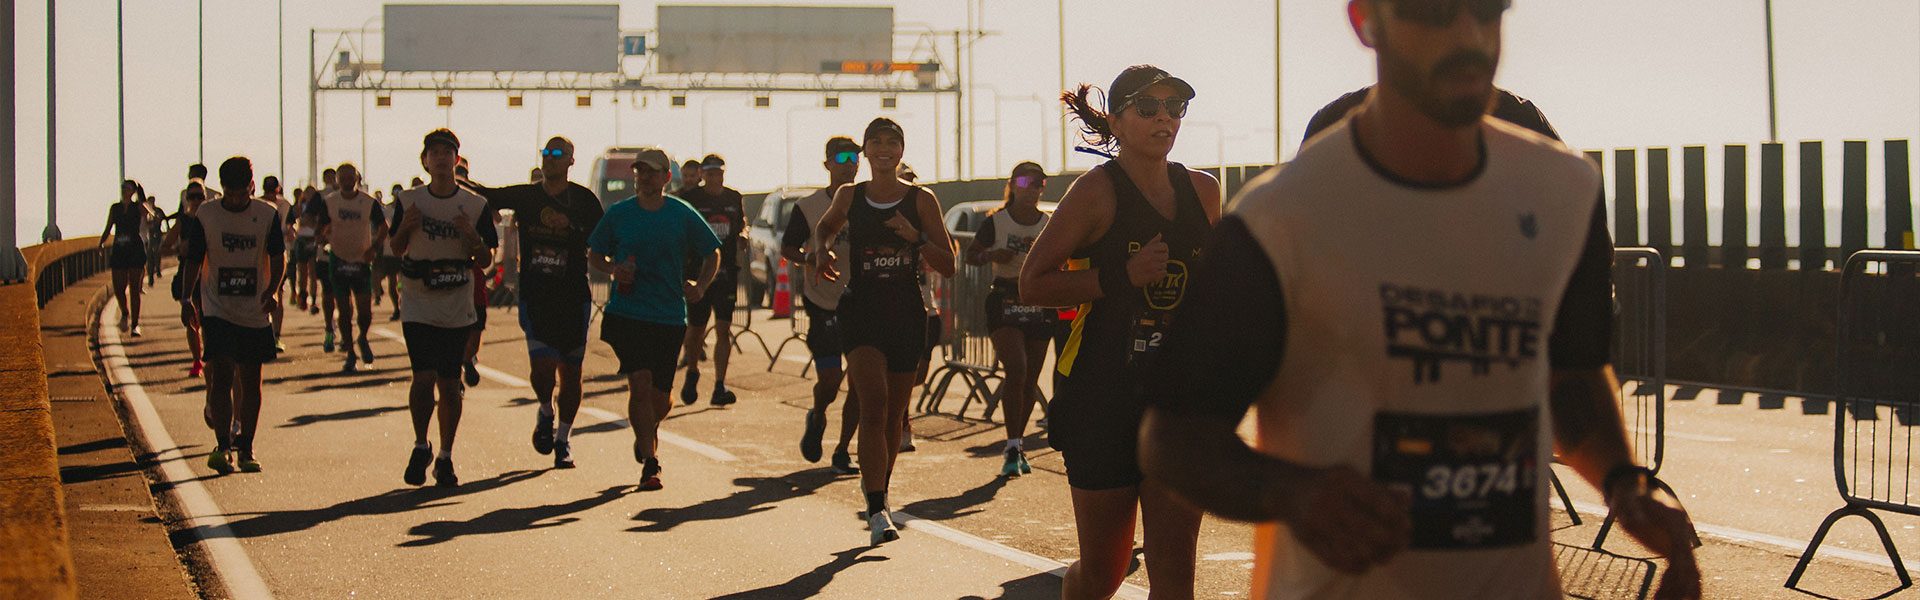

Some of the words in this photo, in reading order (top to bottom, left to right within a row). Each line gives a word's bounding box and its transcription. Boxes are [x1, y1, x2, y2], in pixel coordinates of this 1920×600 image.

[629, 38, 640, 54] 7
[873, 256, 901, 268] 1061
[1383, 306, 1540, 358] PONTE
[1421, 461, 1518, 500] 3674
